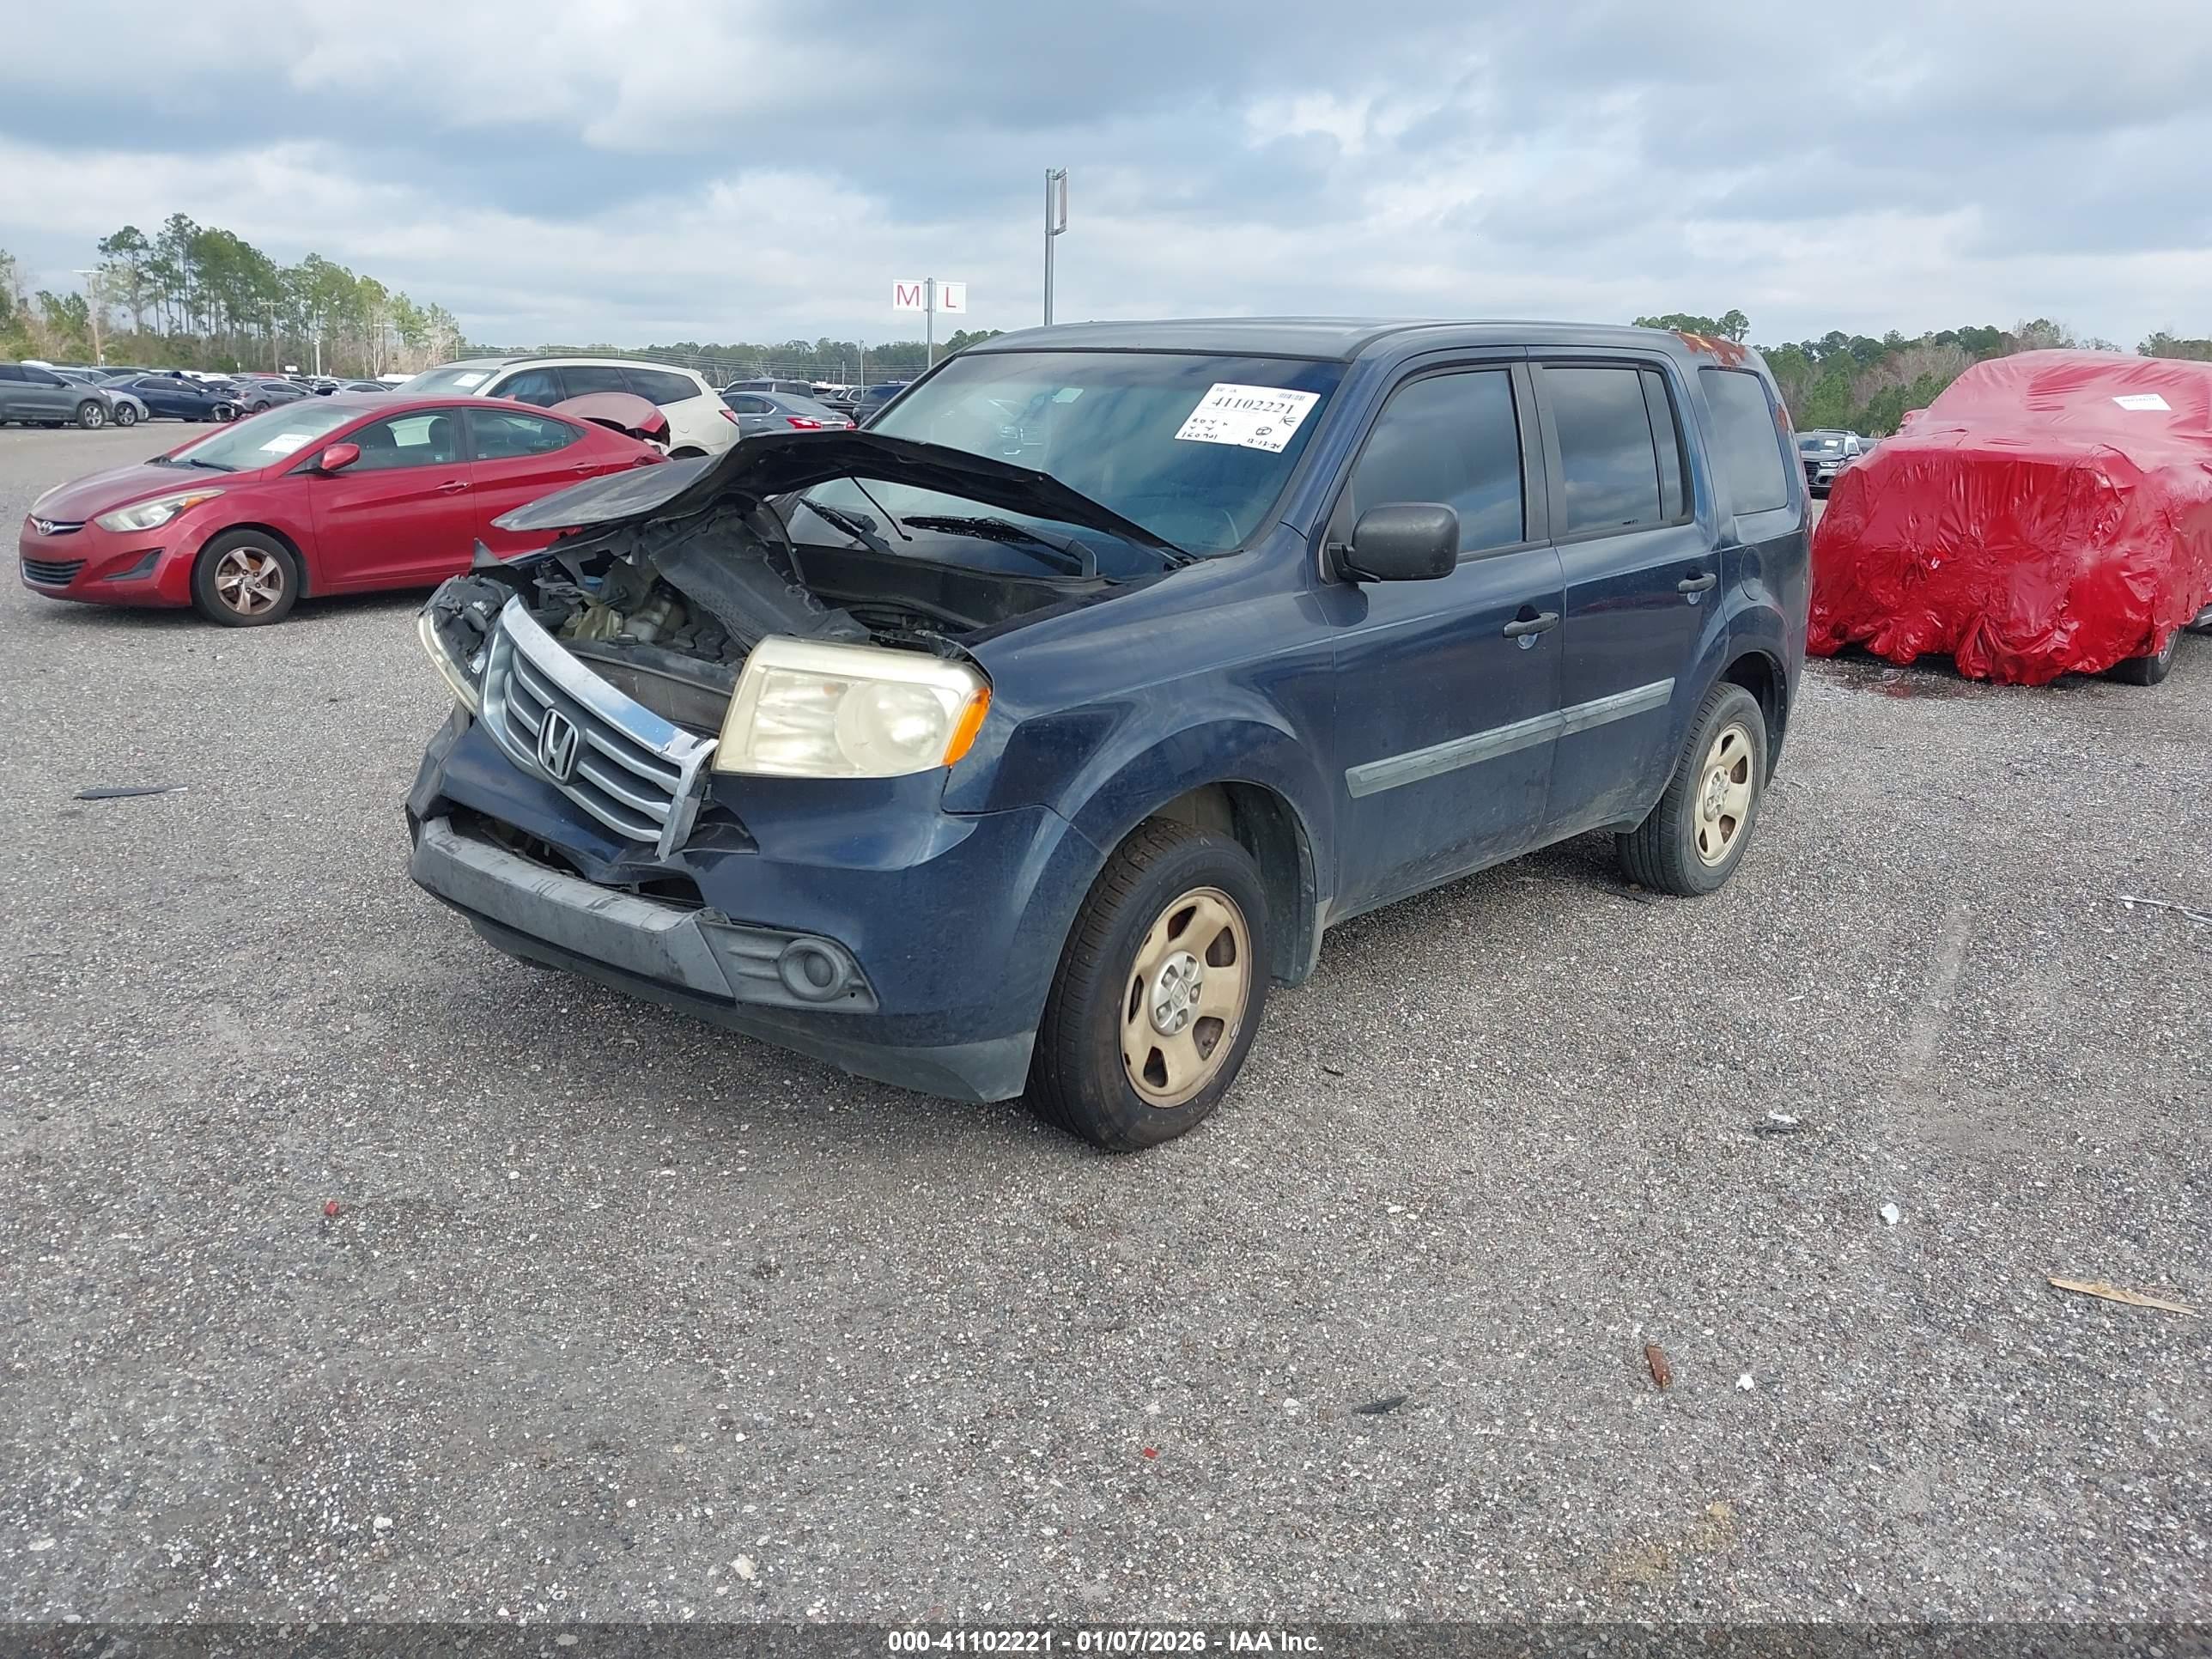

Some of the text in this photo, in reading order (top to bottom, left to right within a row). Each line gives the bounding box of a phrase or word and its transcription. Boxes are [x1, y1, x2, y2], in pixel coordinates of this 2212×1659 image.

[896, 284, 920, 307] M
[945, 286, 957, 308] L
[1212, 396, 1296, 415] 41102221
